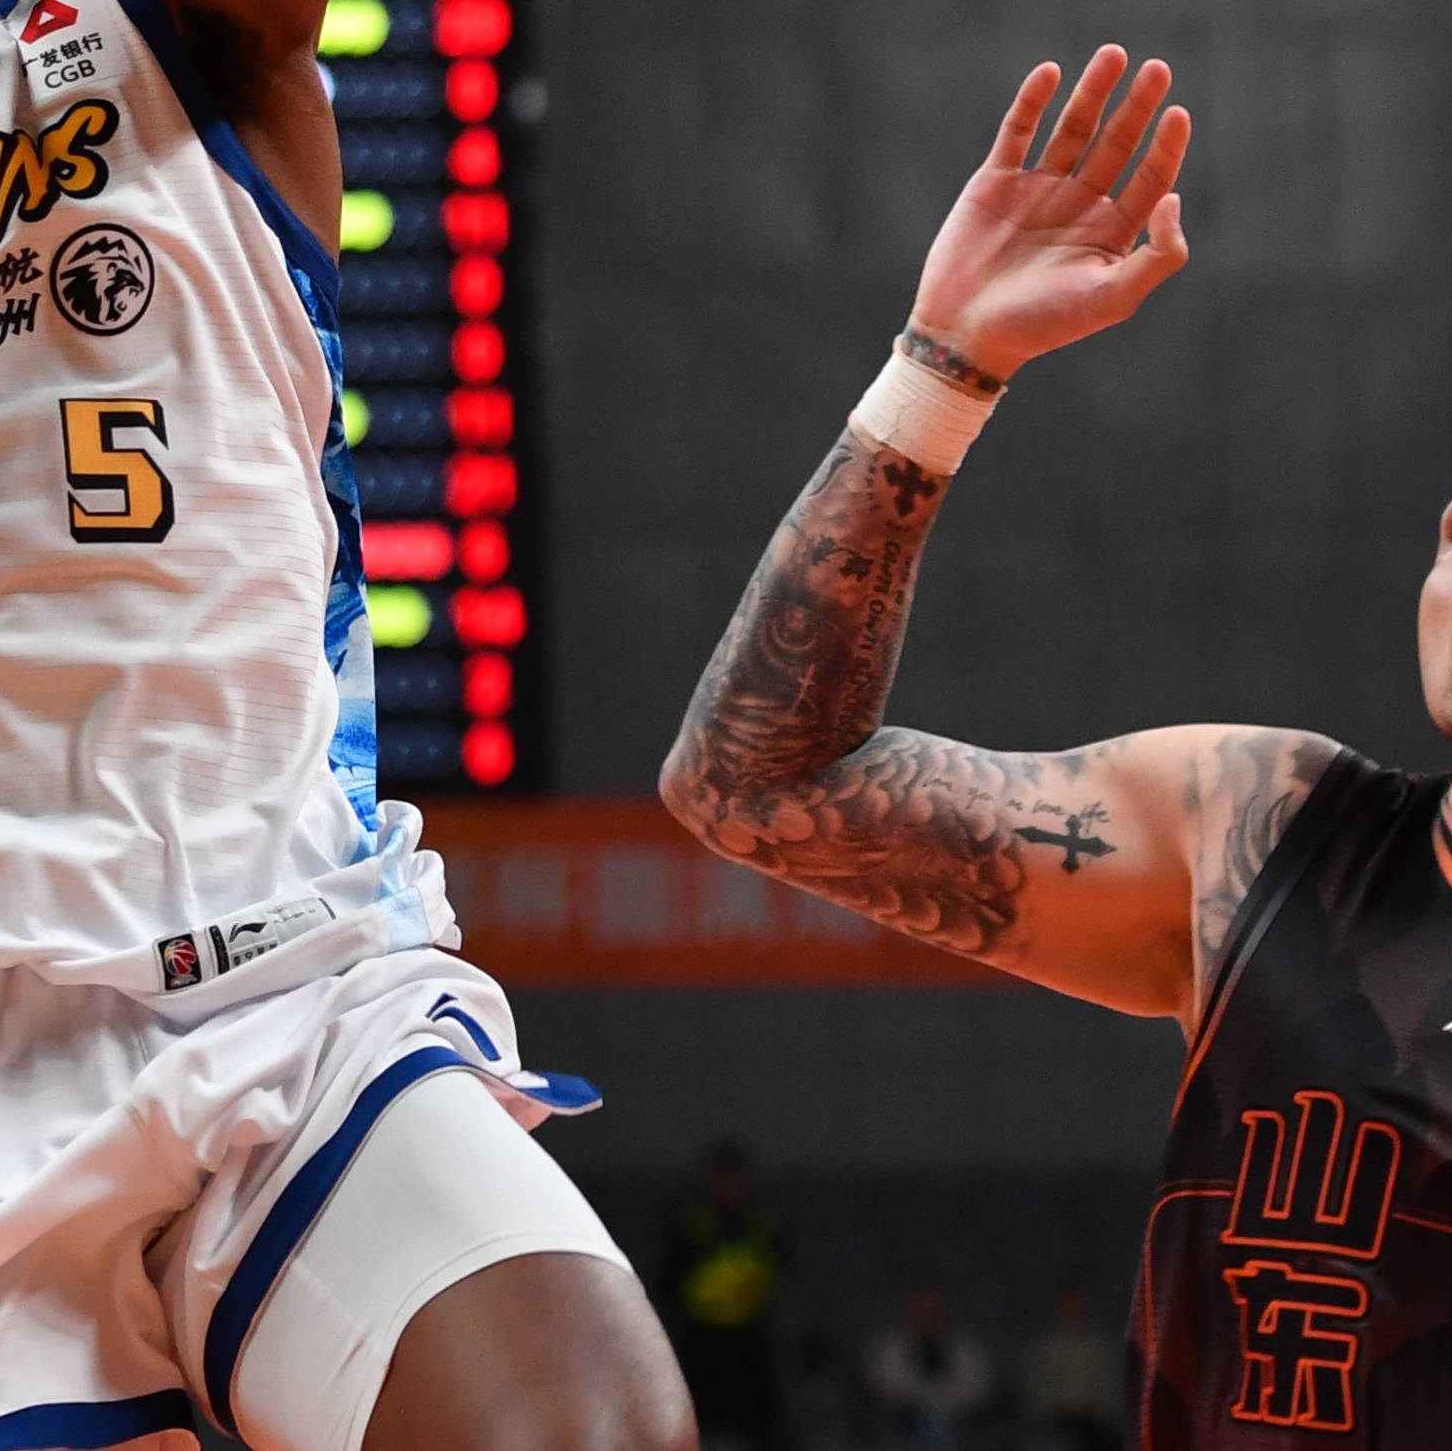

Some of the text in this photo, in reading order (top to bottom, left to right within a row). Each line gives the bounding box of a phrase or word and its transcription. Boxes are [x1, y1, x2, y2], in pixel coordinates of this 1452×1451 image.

[44, 59, 97, 89] CGB
[58, 397, 176, 545] 5
[1220, 1089, 1402, 1432] 山东
